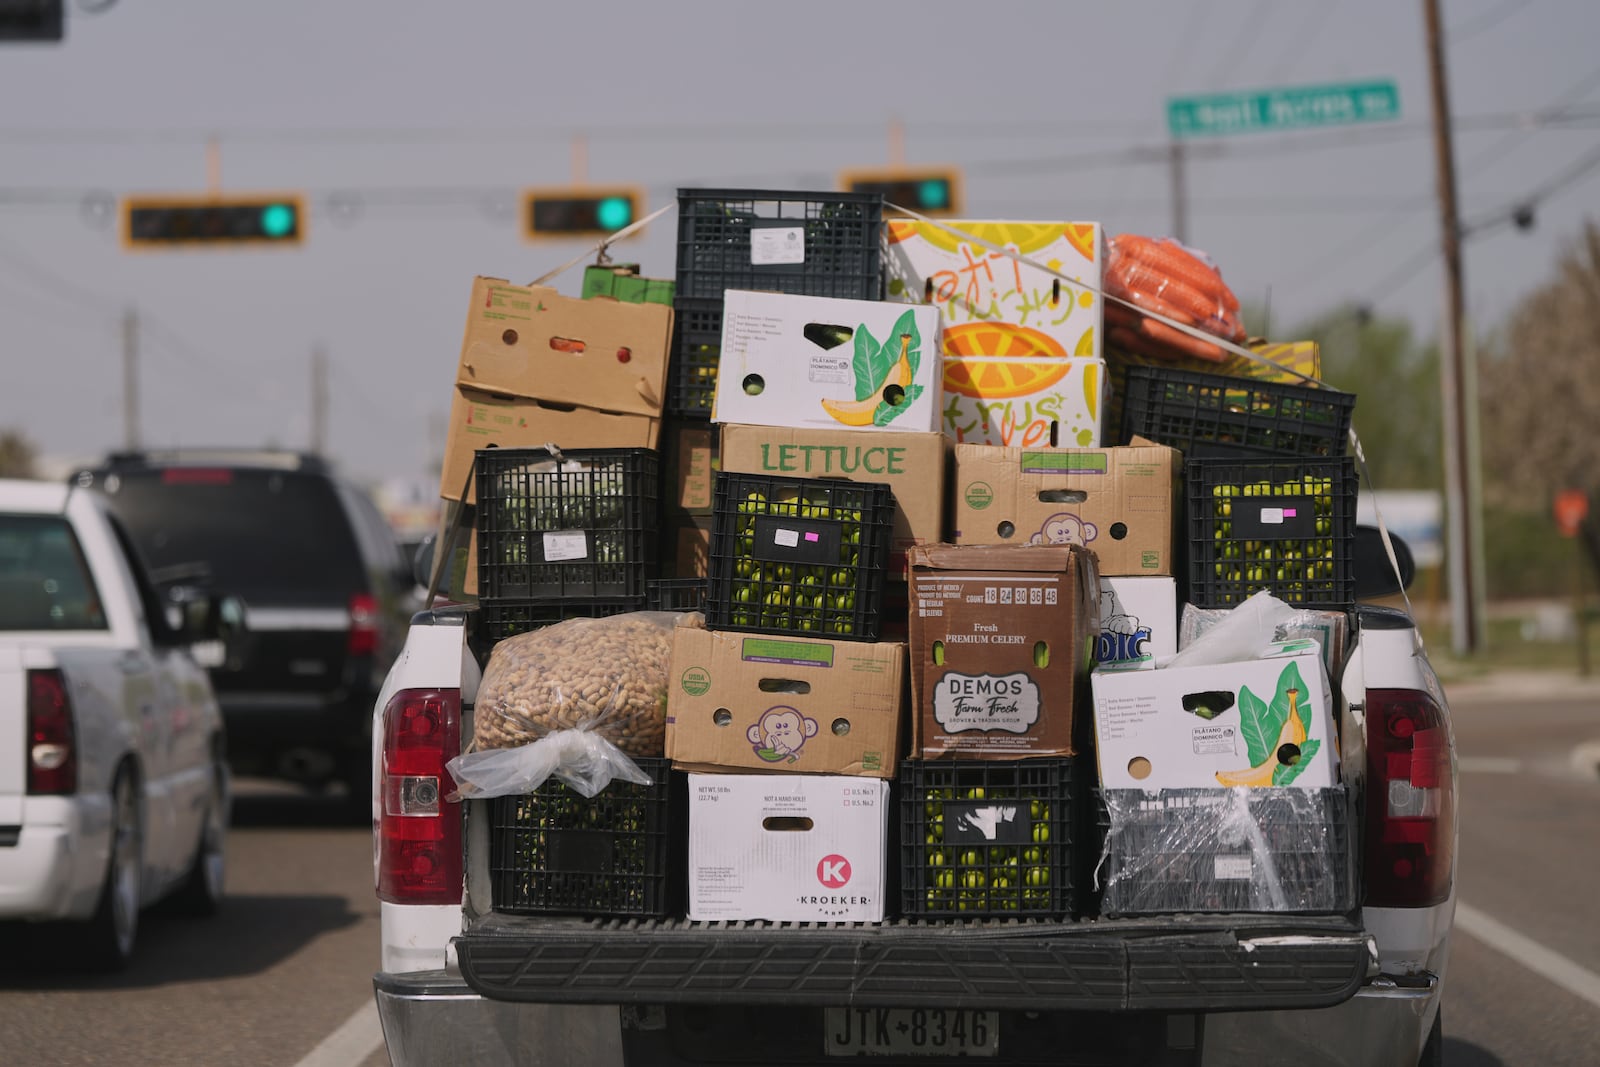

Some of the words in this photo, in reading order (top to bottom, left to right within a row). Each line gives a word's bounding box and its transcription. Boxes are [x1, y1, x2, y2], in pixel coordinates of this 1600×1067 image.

[940, 285, 1075, 326] Citru
[761, 443, 907, 474] LETTUCE
[966, 595, 984, 603] COUNT
[986, 589, 996, 601] 18
[1001, 589, 1011, 601] 24
[1016, 590, 1026, 601] 30
[1031, 590, 1041, 602] 36
[1046, 590, 1056, 602] 48
[926, 609, 943, 617] SLEEVED
[974, 623, 999, 632] Fresh
[945, 634, 989, 644] PREMIUM
[991, 635, 1027, 645] CELERY
[950, 679, 1022, 695] DEMOS
[952, 696, 984, 717] Farm
[986, 696, 1019, 717] Fresh
[852, 799, 862, 807] U.S.
[823, 861, 847, 883] K
[801, 896, 868, 905] KROEKER
[836, 1008, 891, 1046] JTK
[911, 1009, 988, 1048] 8346
